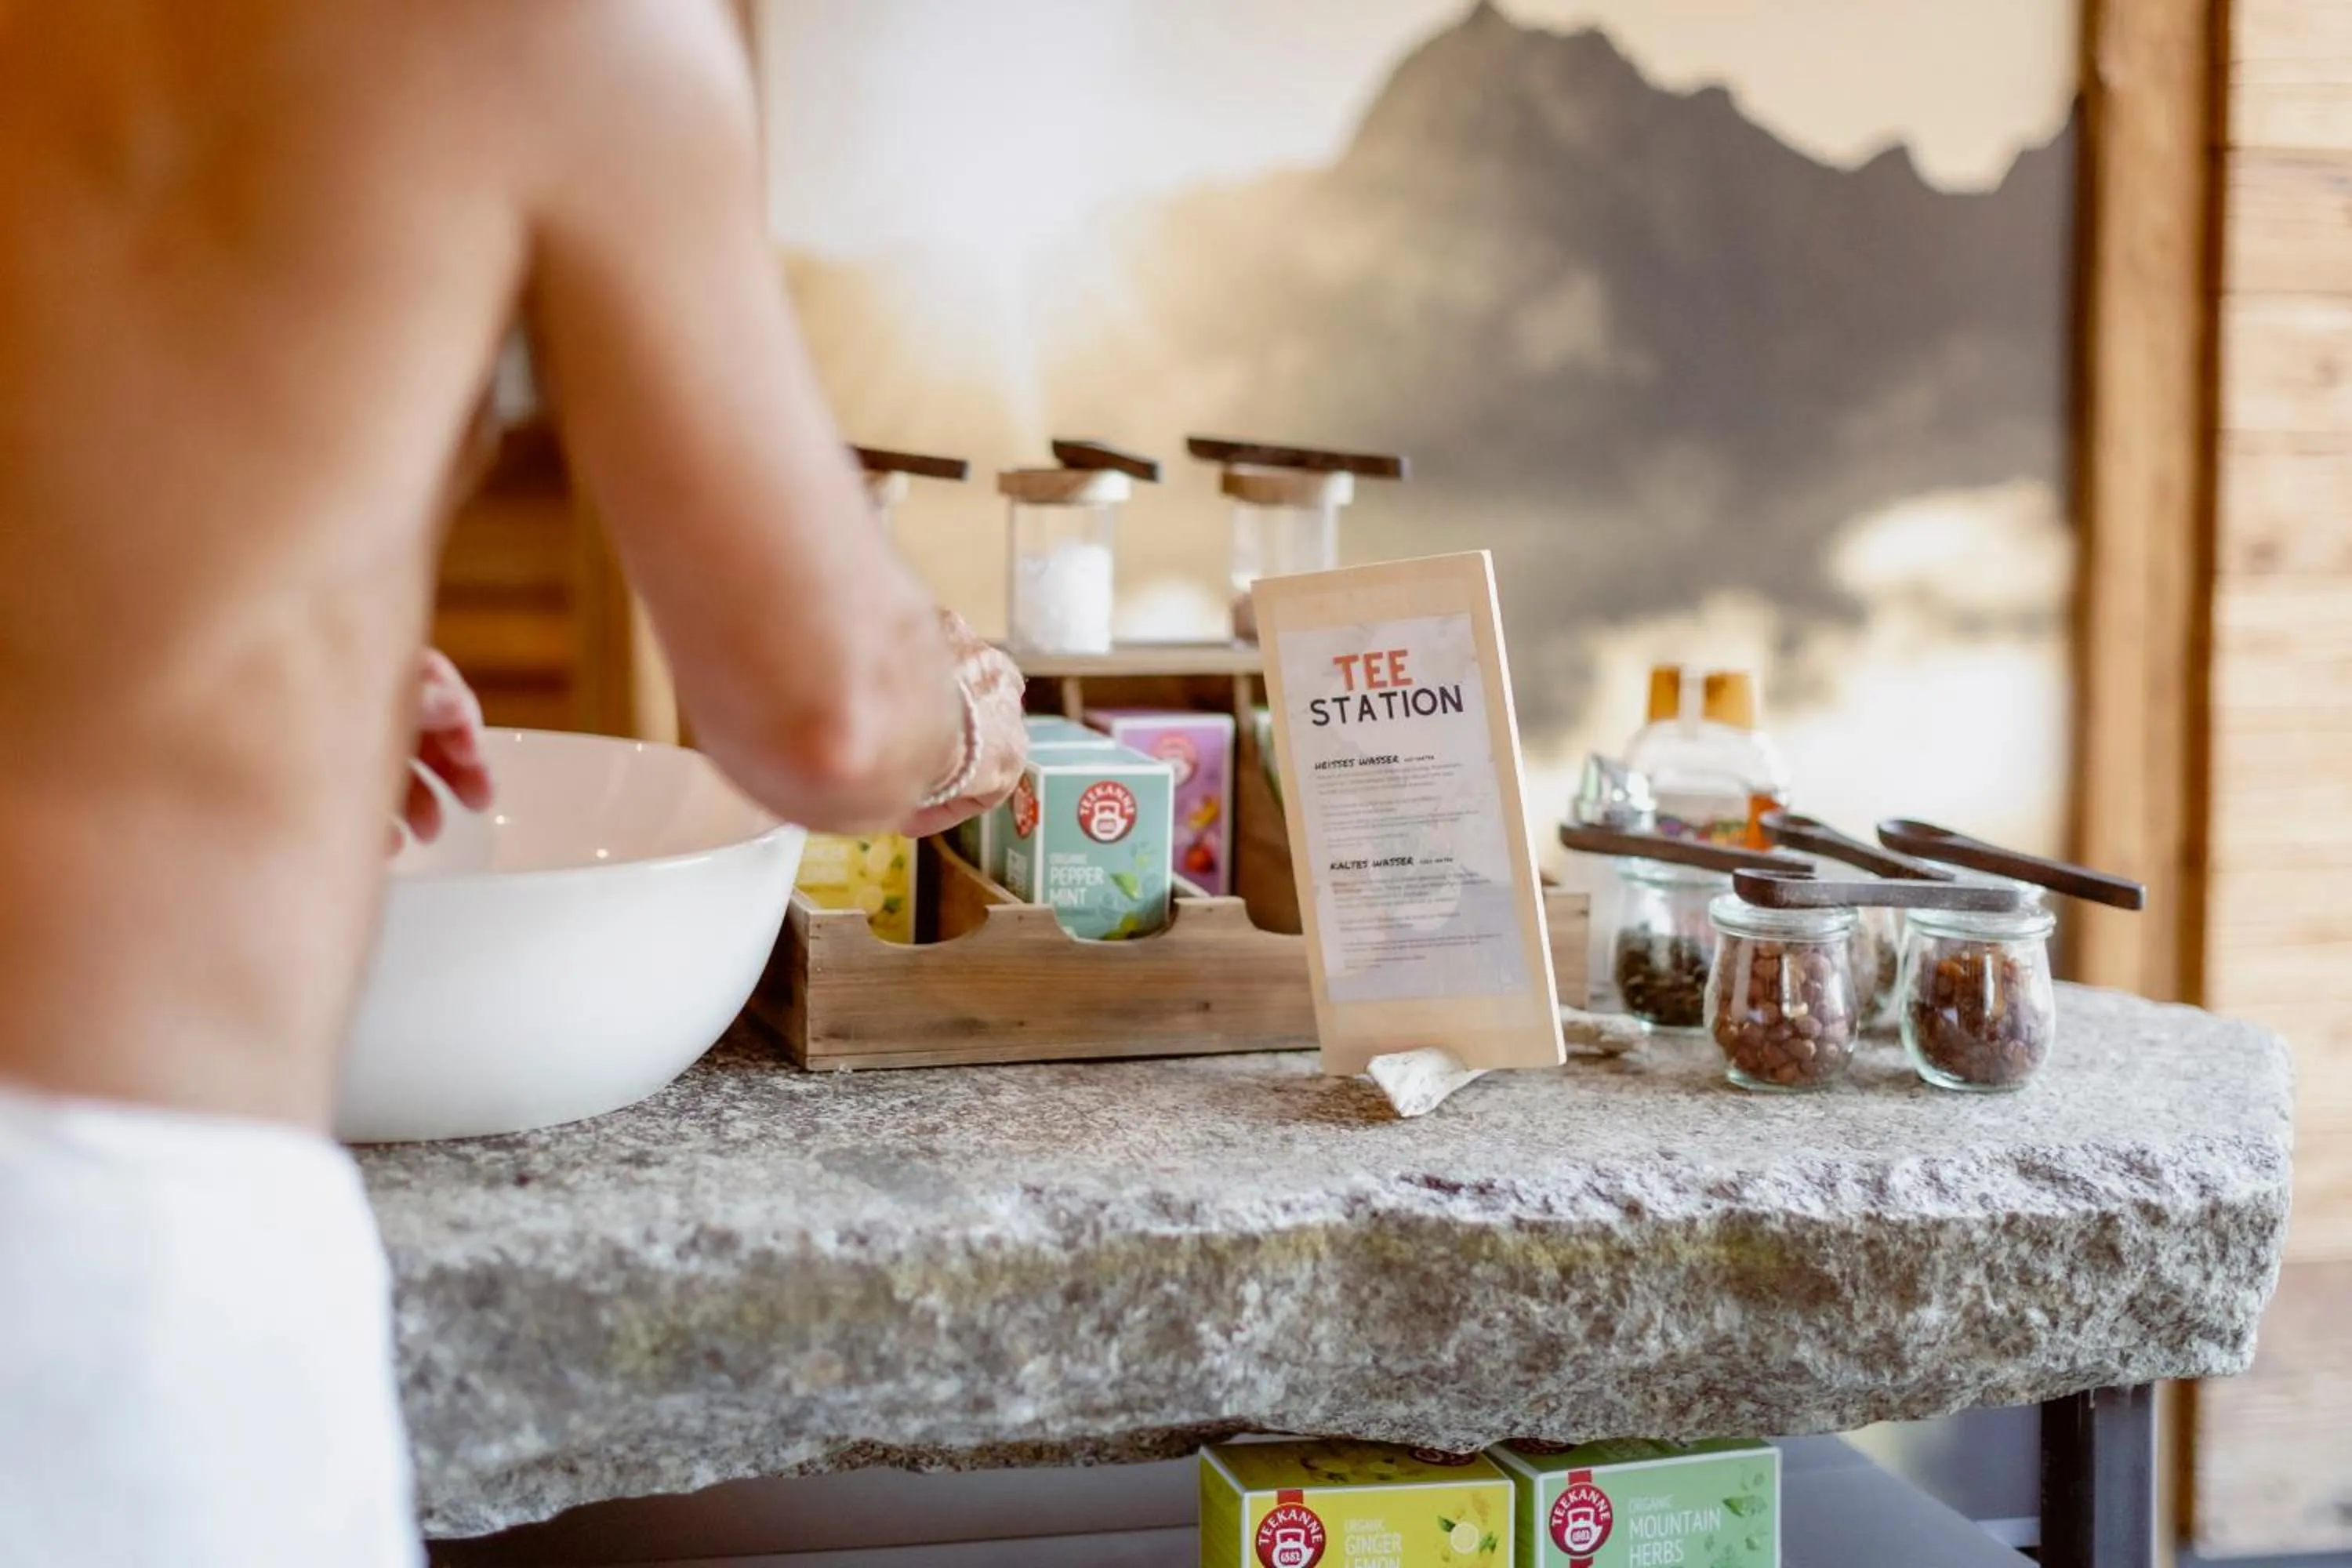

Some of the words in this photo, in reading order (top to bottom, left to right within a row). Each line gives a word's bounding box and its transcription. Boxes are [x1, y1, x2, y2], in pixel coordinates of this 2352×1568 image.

[1333, 649, 1414, 691] TEE
[1310, 684, 1464, 726] STATION
[1314, 758, 1356, 771] HEISSES
[1359, 755, 1399, 766] WASSER
[1049, 866, 1105, 886] PEPPER
[1330, 859, 1368, 871] KALTES
[1371, 856, 1414, 869] WASSER
[1048, 887, 1087, 907] MINT
[1552, 1488, 1612, 1527] TEEKANNE
[1258, 1508, 1324, 1546] TEEKANNE
[1628, 1506, 1722, 1540] MOUNTAIN
[1344, 1532, 1403, 1555] GINGER
[1628, 1539, 1685, 1568] HERBS
